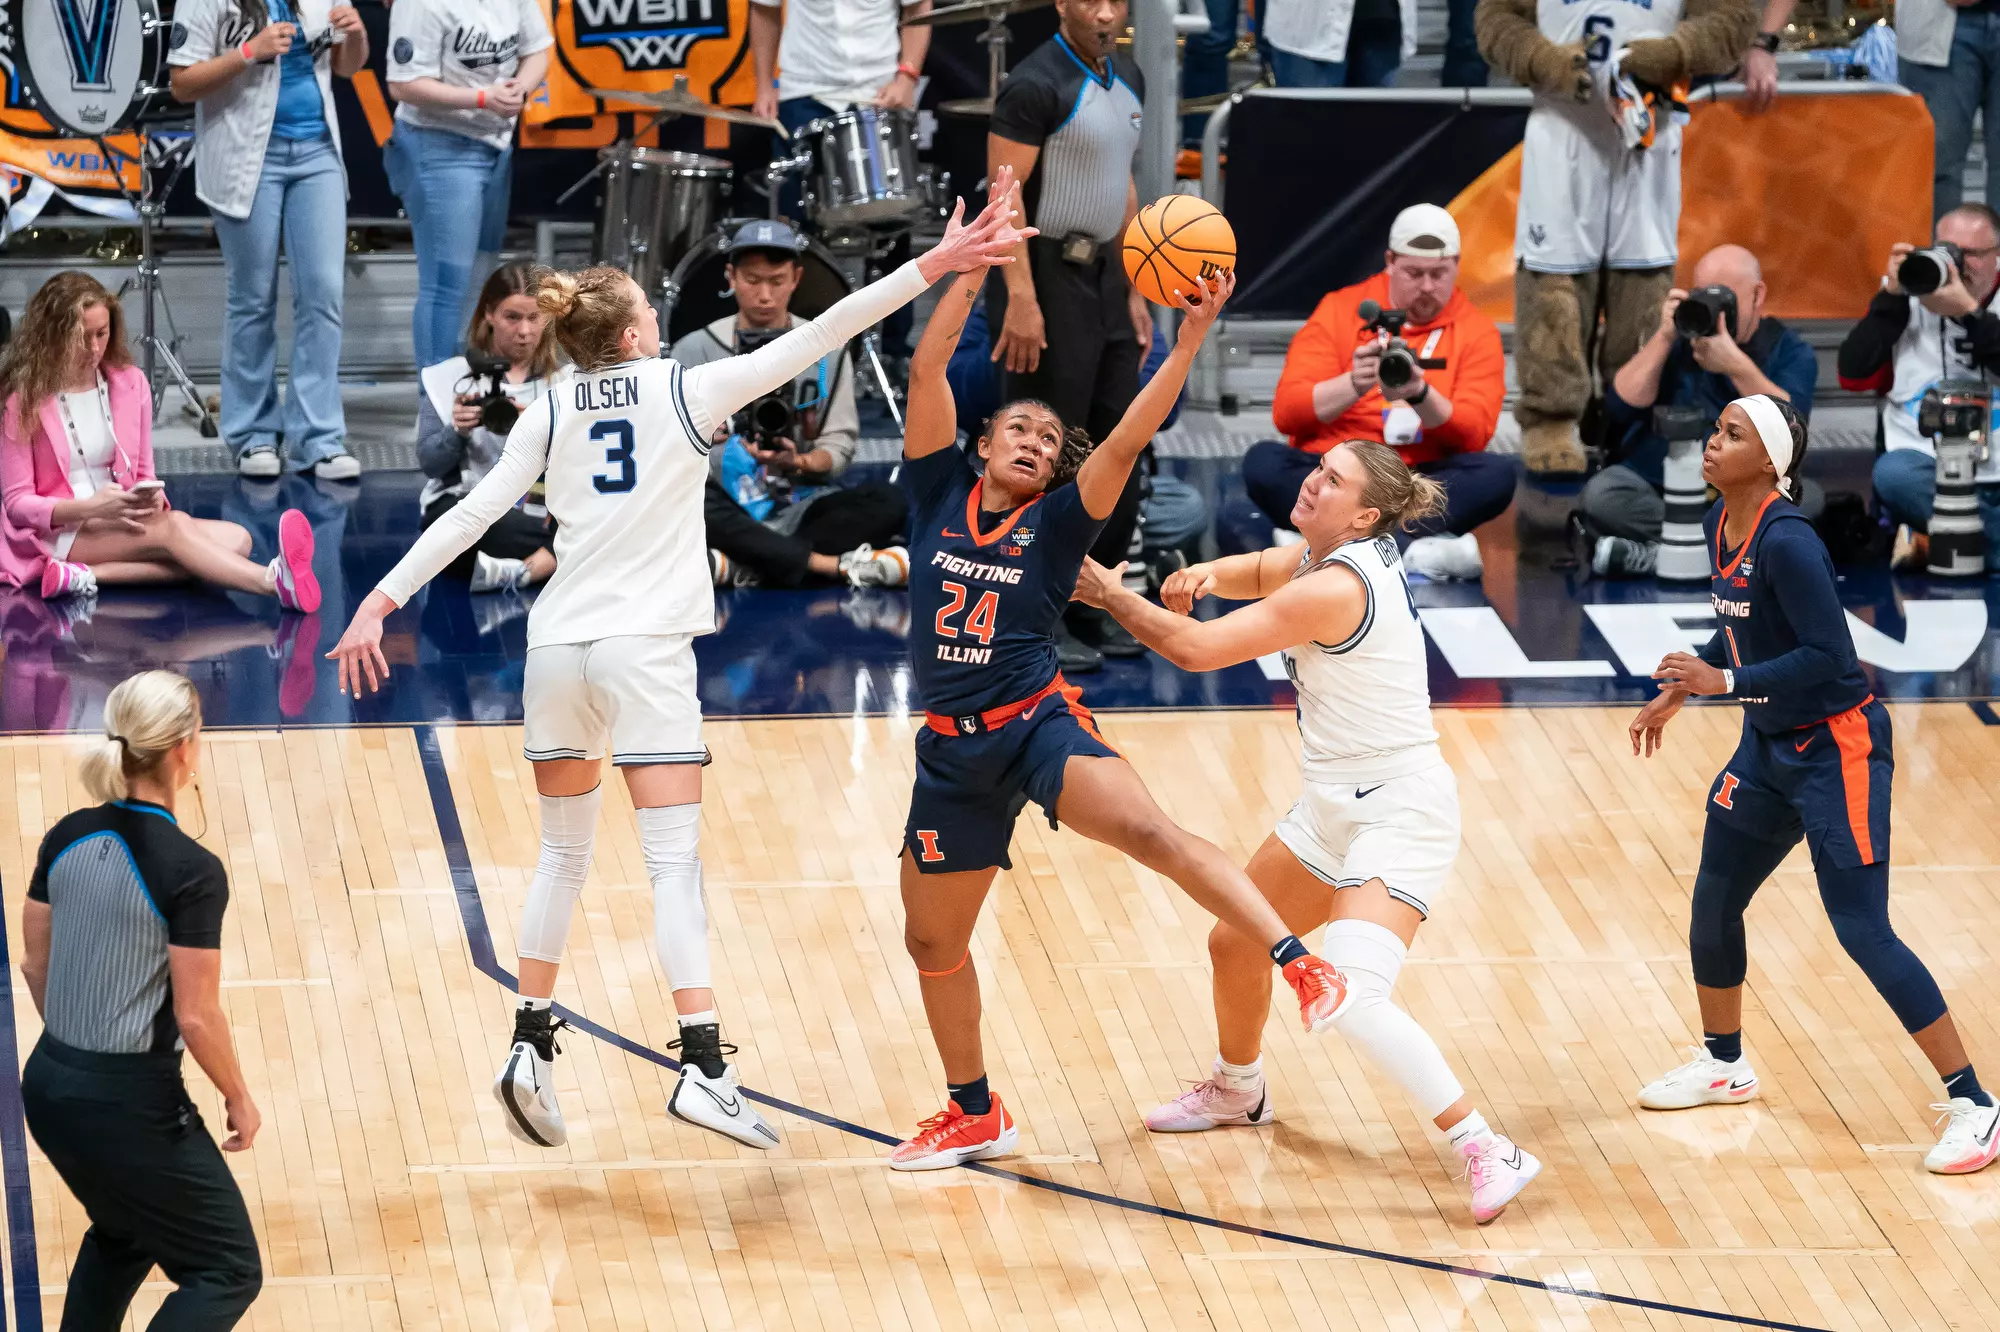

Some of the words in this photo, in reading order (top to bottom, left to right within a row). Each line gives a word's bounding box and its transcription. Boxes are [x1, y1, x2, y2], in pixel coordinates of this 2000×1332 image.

[1584, 15, 1614, 62] 6
[575, 376, 638, 411] OLSEN
[588, 418, 638, 495] 3
[931, 551, 1024, 584] FIGHTING
[935, 580, 1000, 645] 24
[937, 644, 993, 665] ILLINI
[916, 829, 946, 862] I
